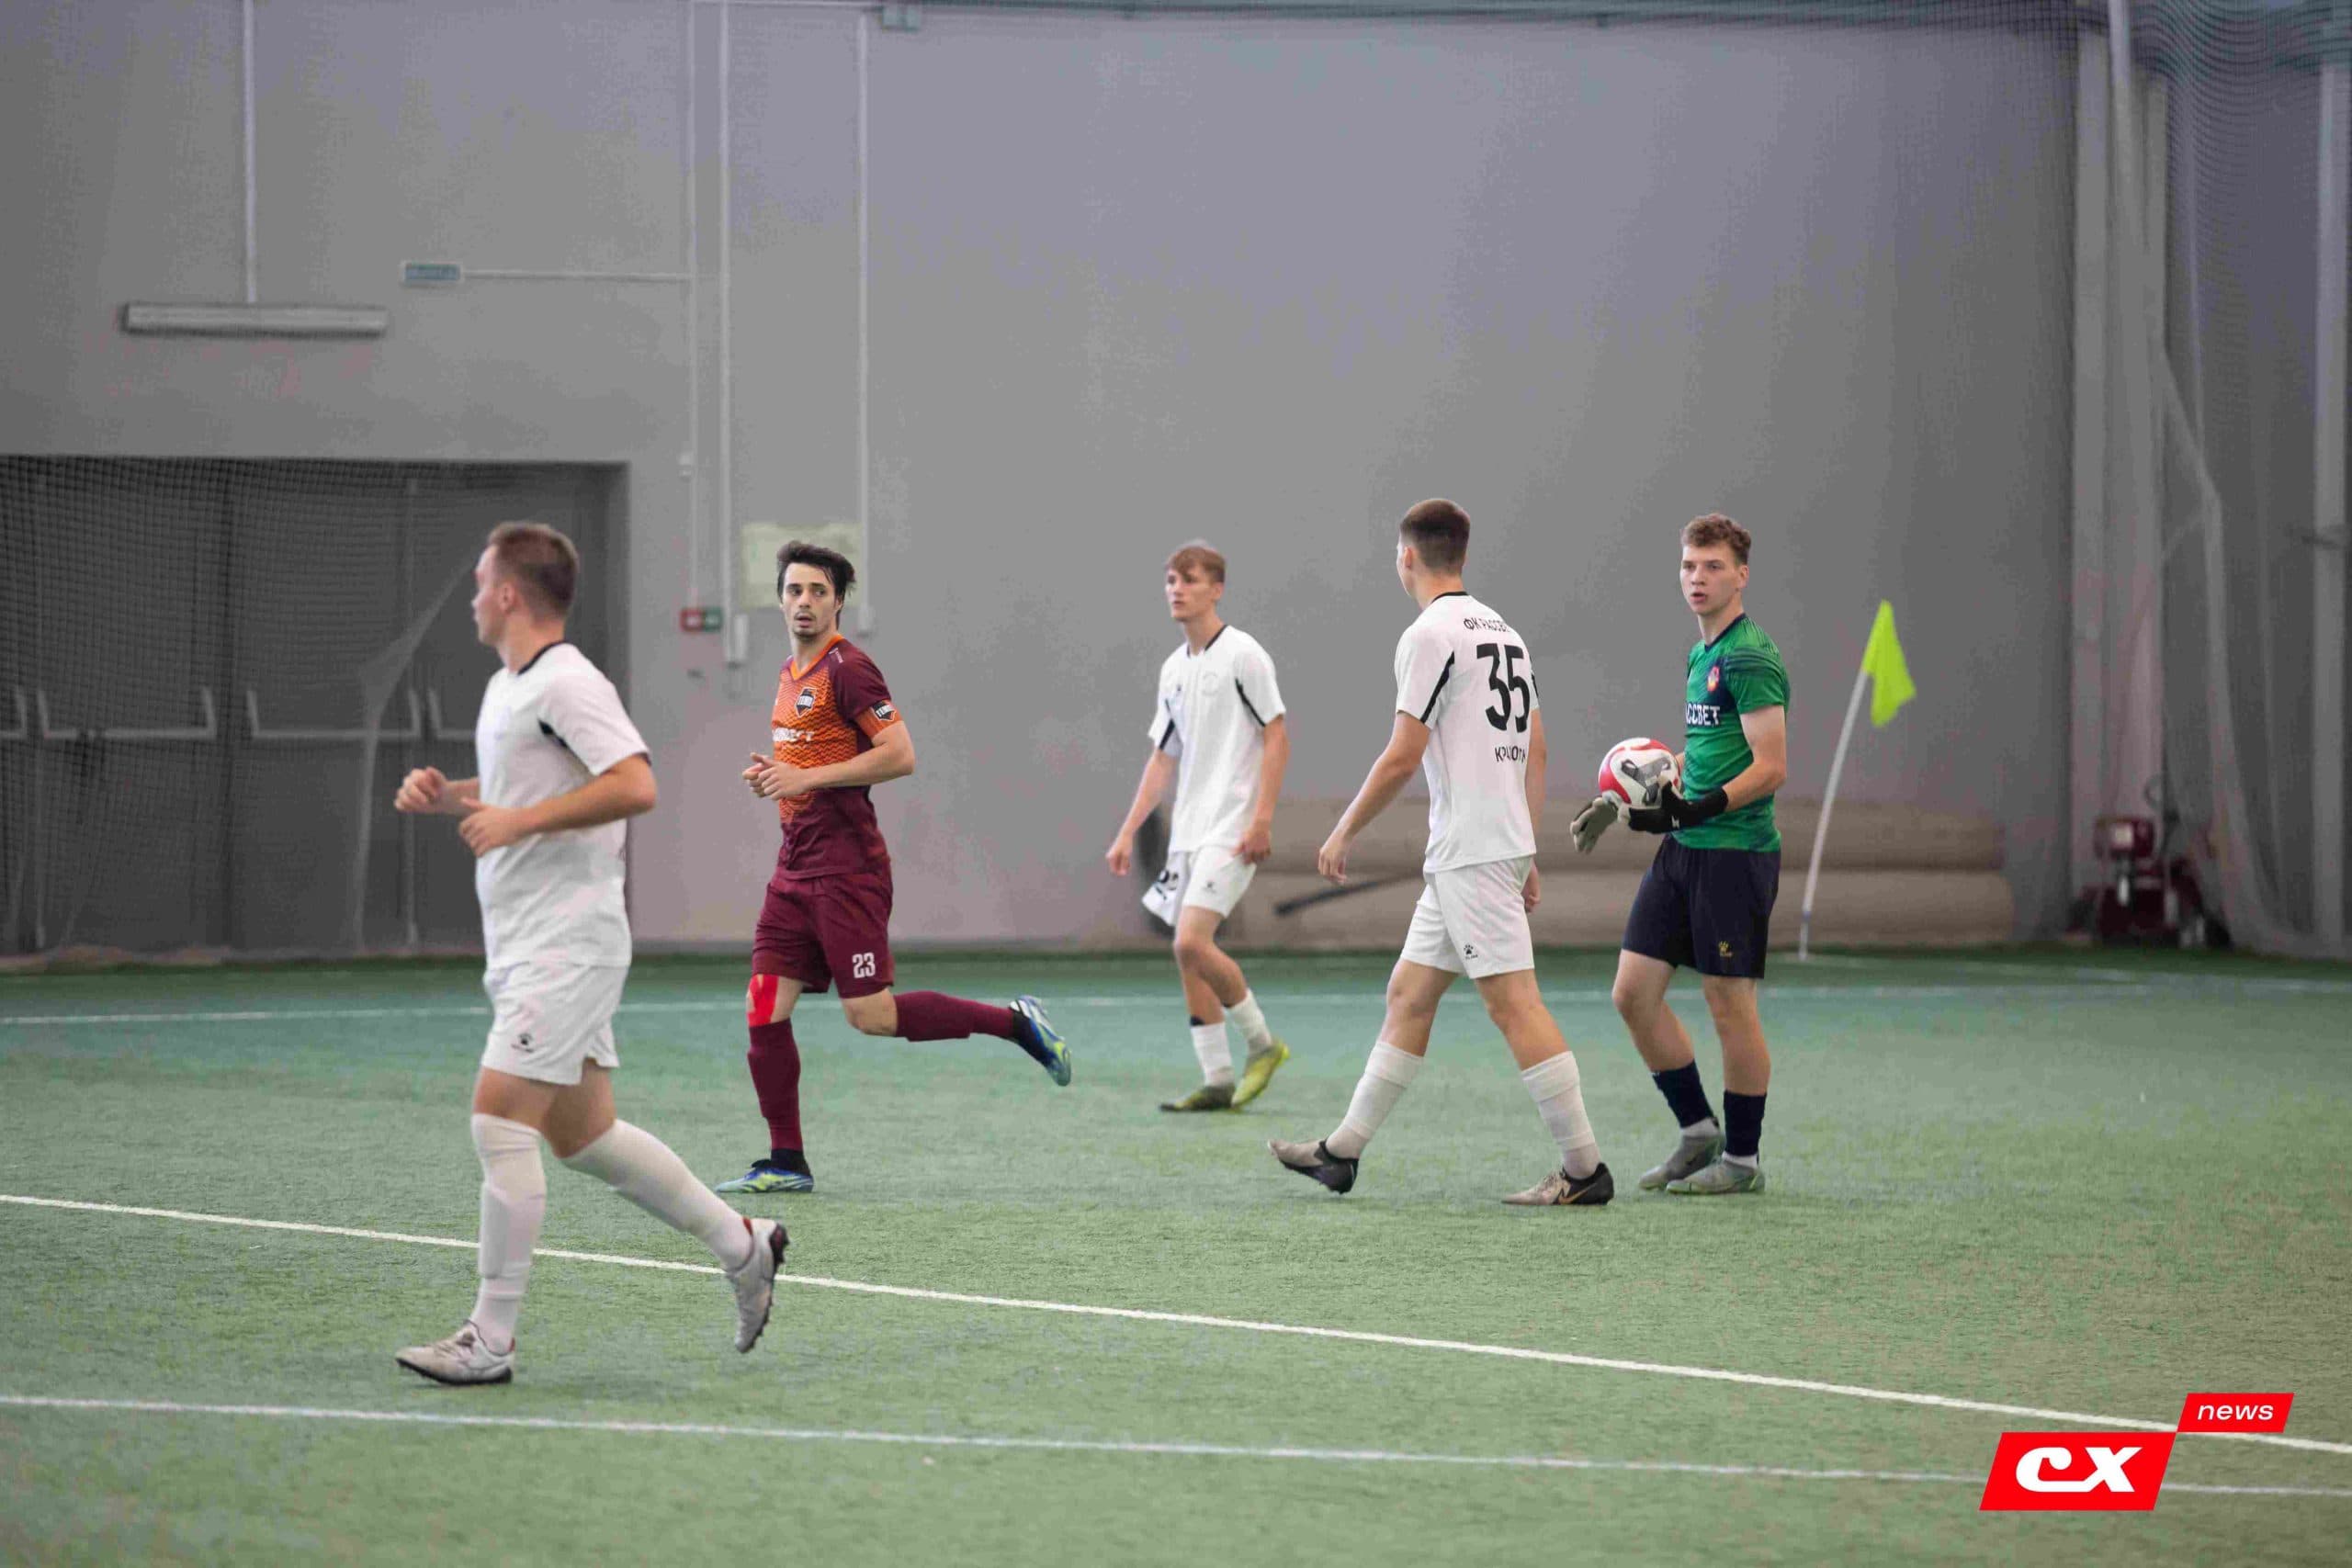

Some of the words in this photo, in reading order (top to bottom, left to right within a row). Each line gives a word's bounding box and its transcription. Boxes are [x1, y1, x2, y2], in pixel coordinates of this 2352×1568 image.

[1464, 617, 1481, 631] ФК
[1476, 643, 1530, 732] 35
[853, 953, 876, 978] 23
